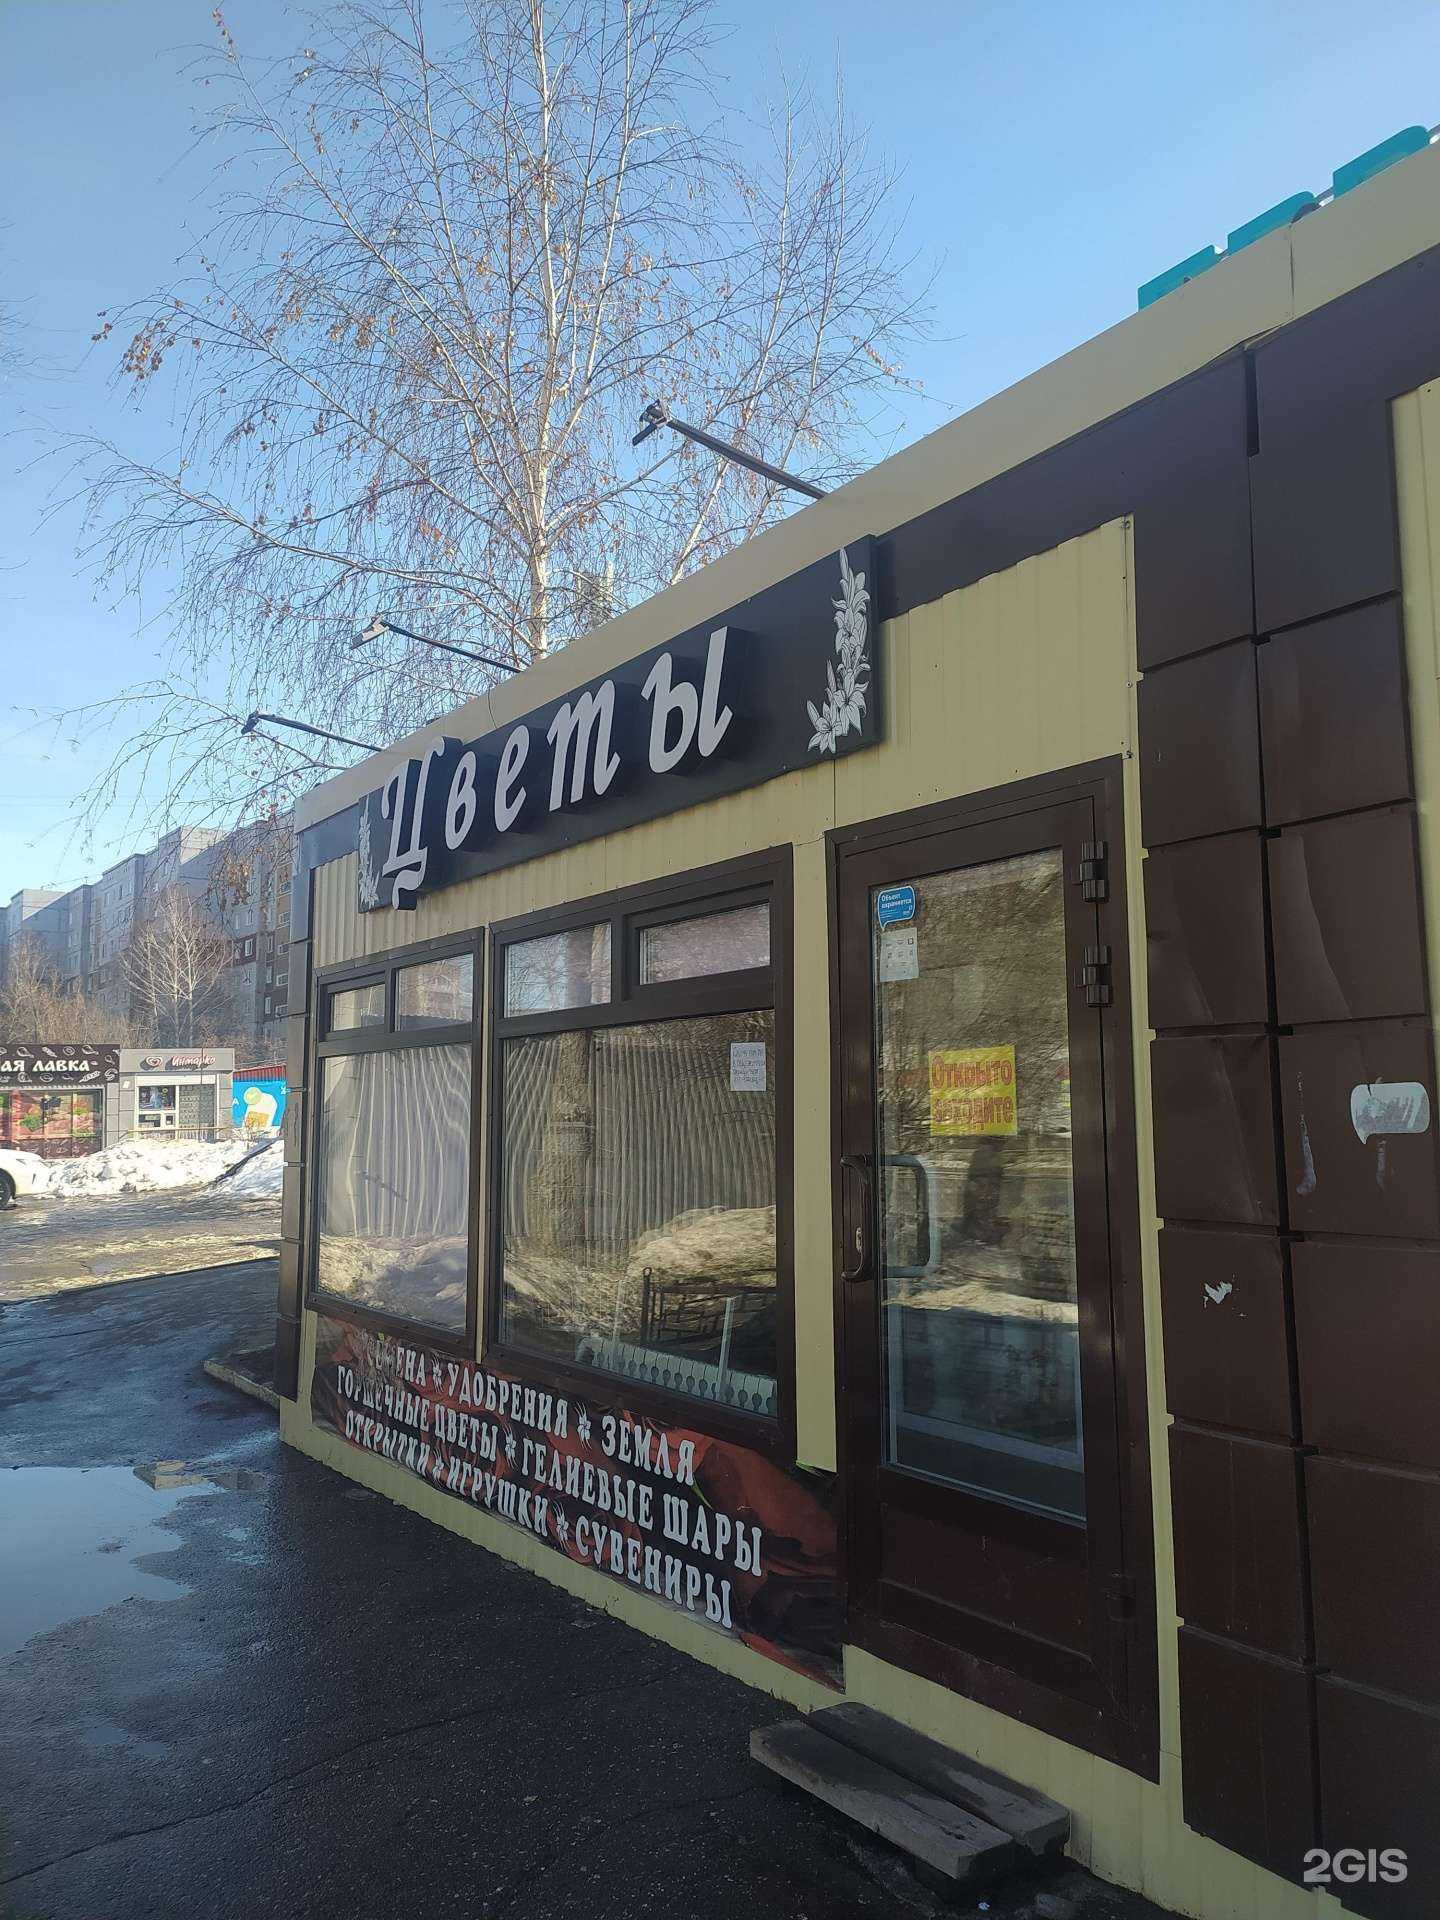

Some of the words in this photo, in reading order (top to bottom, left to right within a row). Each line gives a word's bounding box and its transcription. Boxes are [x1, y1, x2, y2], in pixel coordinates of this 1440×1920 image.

[381, 626, 733, 909] Цветы
[345, 1409, 431, 1477] ОТКРЫТКИ
[449, 1455, 548, 1537] ИГРУШКИ
[575, 1515, 733, 1629] СУВЕНИРЫ
[434, 1403, 498, 1462] ЦВЕТЫ
[521, 1438, 654, 1531] ГЕЛИЕВЫЕ
[662, 1492, 762, 1577] ШАРЫ
[447, 1362, 568, 1439] УДОБРЕНИЯ
[601, 1415, 696, 1486] ЗЕМЛЯ
